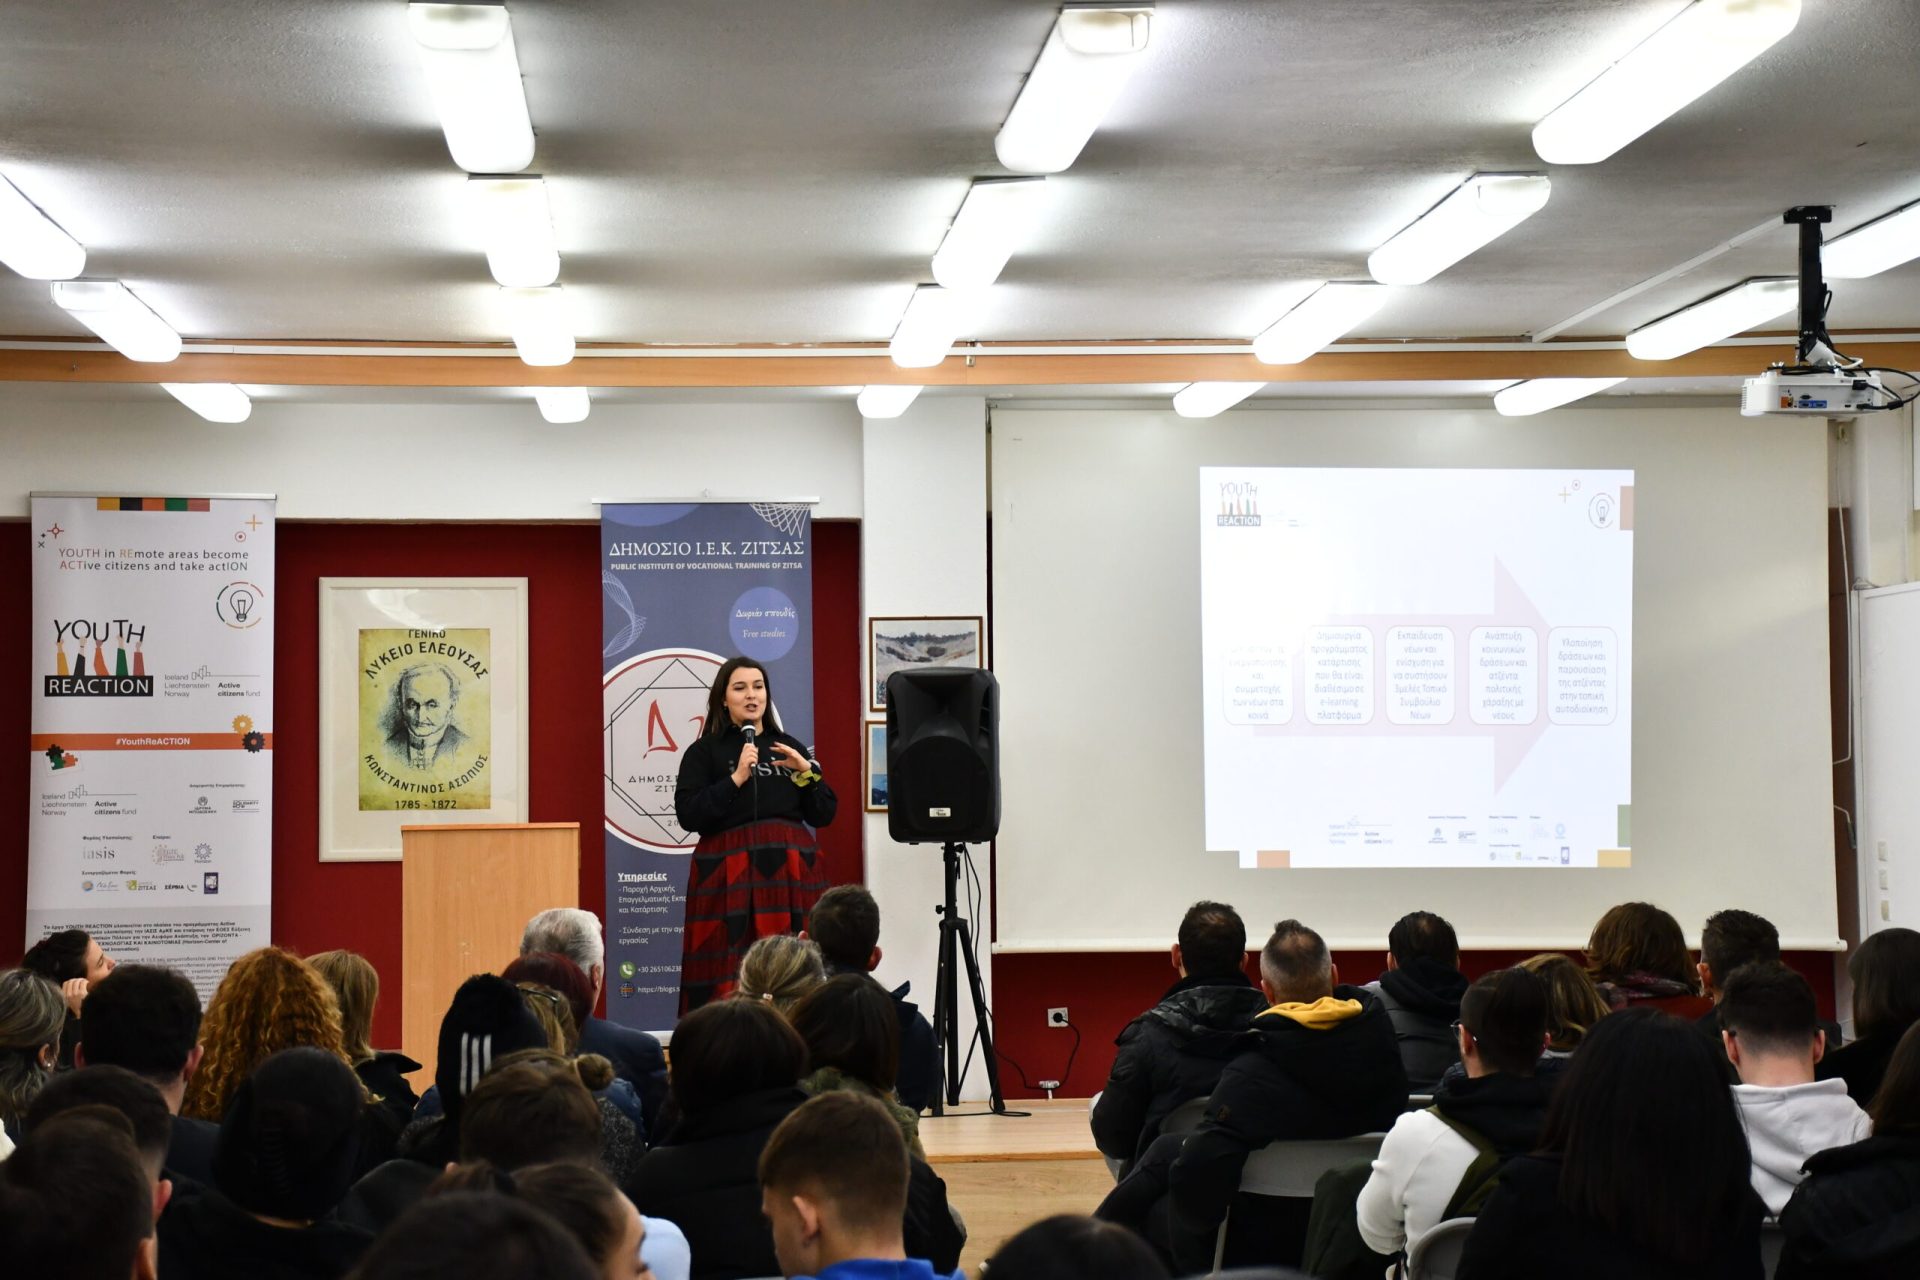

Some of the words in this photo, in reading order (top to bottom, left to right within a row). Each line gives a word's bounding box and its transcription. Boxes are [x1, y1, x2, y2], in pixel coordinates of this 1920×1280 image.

[1220, 482, 1258, 497] YOUTH
[1219, 516, 1260, 525] REACTION
[59, 548, 100, 558] YOUTH
[104, 549, 115, 558] in
[120, 548, 164, 558] REmote
[168, 551, 199, 559] areas
[203, 549, 249, 559] become
[609, 542, 691, 556] ΔΗΜΟΣΙΟ
[696, 542, 736, 556] Ι.Ε.Κ.
[741, 541, 804, 555] ΖΙΤΣΑΣ
[60, 560, 100, 570] ACTive
[104, 560, 150, 570] citizens
[154, 562, 176, 570] and
[180, 562, 205, 571] take
[208, 562, 248, 571] actION
[54, 619, 145, 644] YOUTH
[743, 629, 760, 638] Free
[760, 628, 786, 638] studies
[366, 643, 414, 679] ΛΥΚΕΙΟ
[419, 642, 488, 680] ΕΛΕΟΥΣΑΣ
[50, 680, 150, 694] REACTION
[164, 690, 190, 698] Norway
[116, 737, 190, 746] #YouthReACTION
[364, 754, 446, 794] ΚΩΝΣΤΑΝΤΙΝΟΣ
[448, 754, 488, 790] ΑΣΩΠΙΟΣ
[396, 800, 421, 810] 1785
[432, 800, 457, 810] 1872
[82, 846, 115, 860] iasis
[618, 871, 667, 882] Υπηρεσίες
[622, 886, 648, 894] Παροχή
[650, 884, 676, 894] Αρχικής
[618, 895, 670, 904] Επαγγελματικής
[630, 906, 668, 914] Κατάρτισης
[622, 926, 651, 934] Σύνδεση
[618, 936, 649, 944] εργασίας
